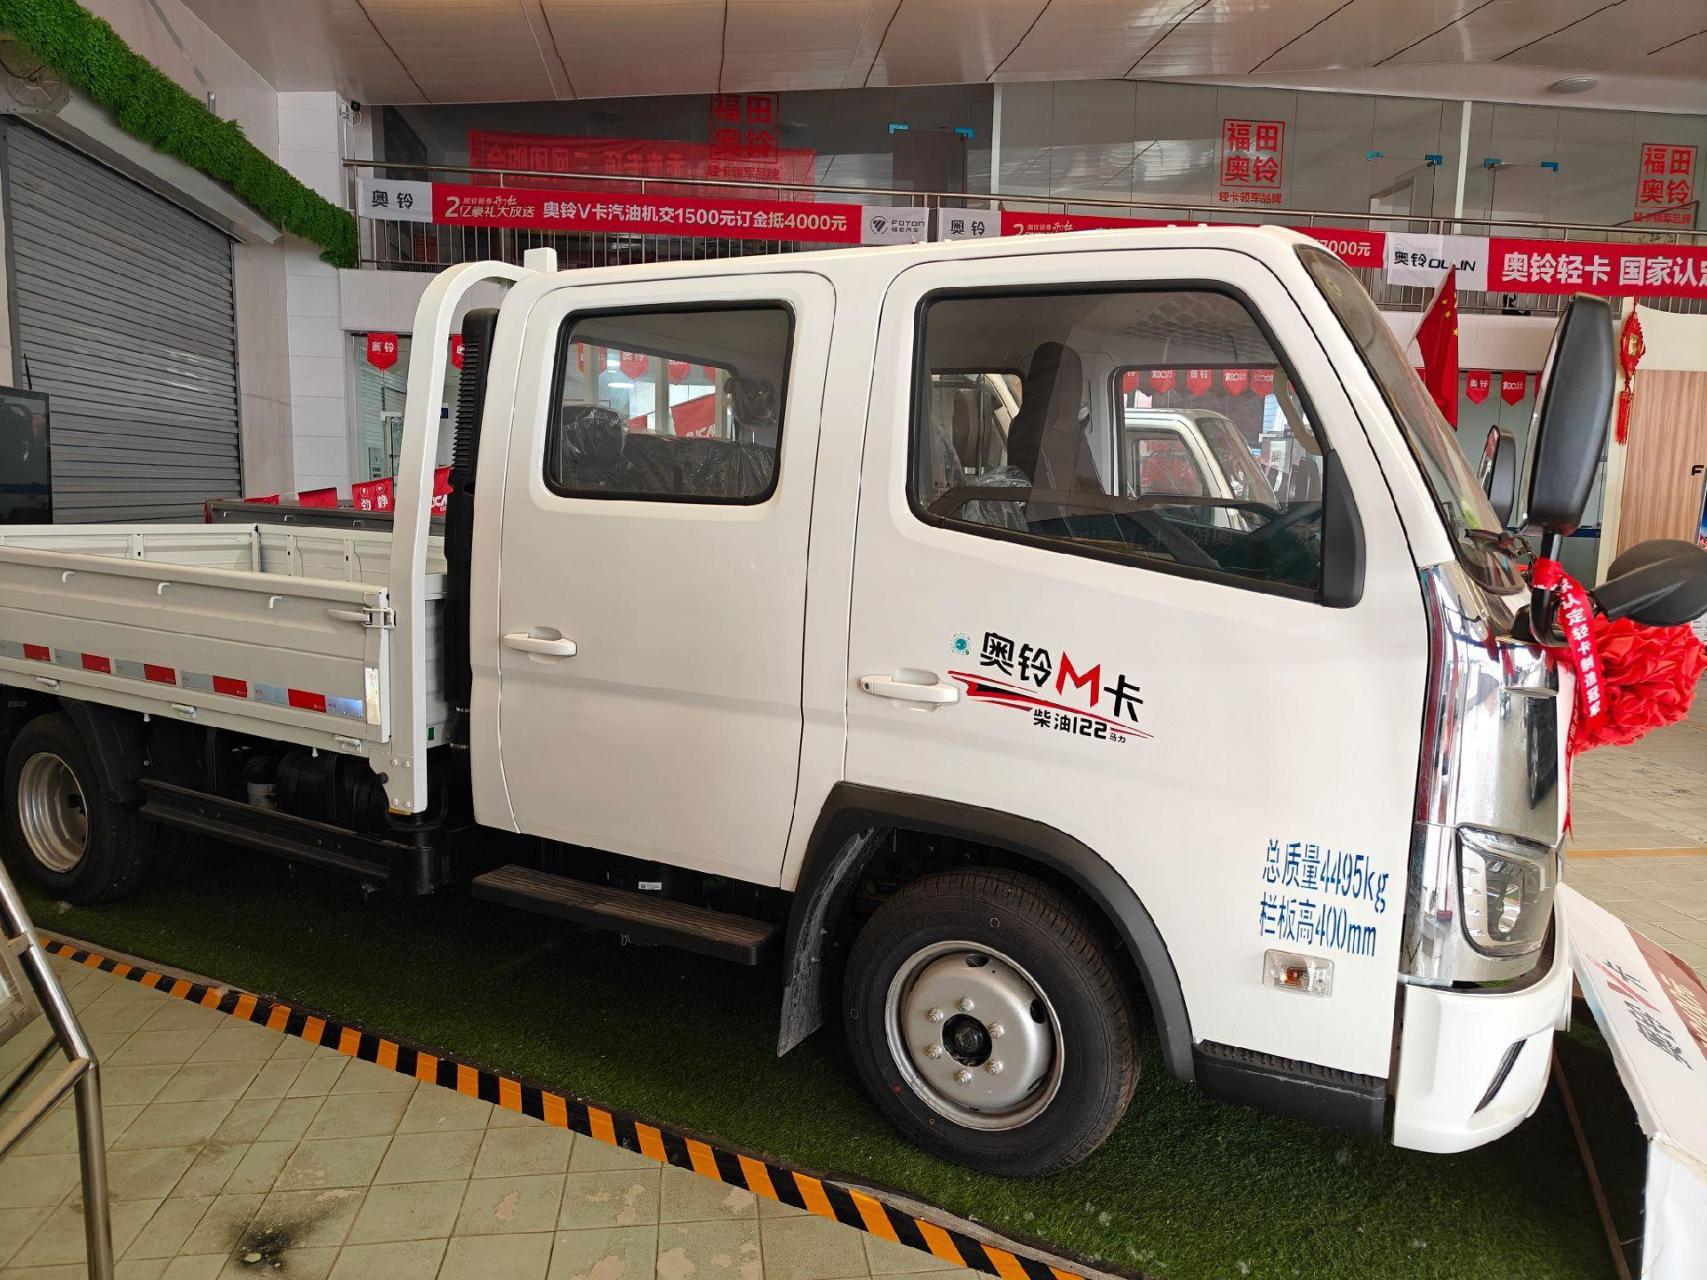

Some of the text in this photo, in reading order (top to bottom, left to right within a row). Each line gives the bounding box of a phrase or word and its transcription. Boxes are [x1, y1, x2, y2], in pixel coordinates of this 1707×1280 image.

[715, 95, 771, 124] 福田
[1227, 123, 1278, 151] 福田
[1225, 156, 1279, 182] 奥铃
[1644, 147, 1692, 175] 福田
[372, 190, 414, 209] 奥铃
[1641, 179, 1690, 206] 奥铃
[543, 201, 847, 231] 奥铃V卡汽油机交1500元订金抵4000元
[950, 220, 986, 236] 奥铃
[1502, 252, 1611, 286] 奥铃轻卡
[980, 631, 1143, 723] 奥铃M卡
[1262, 838, 1389, 914] 总质量4495kg
[1259, 891, 1377, 957] 栏板高400mm
